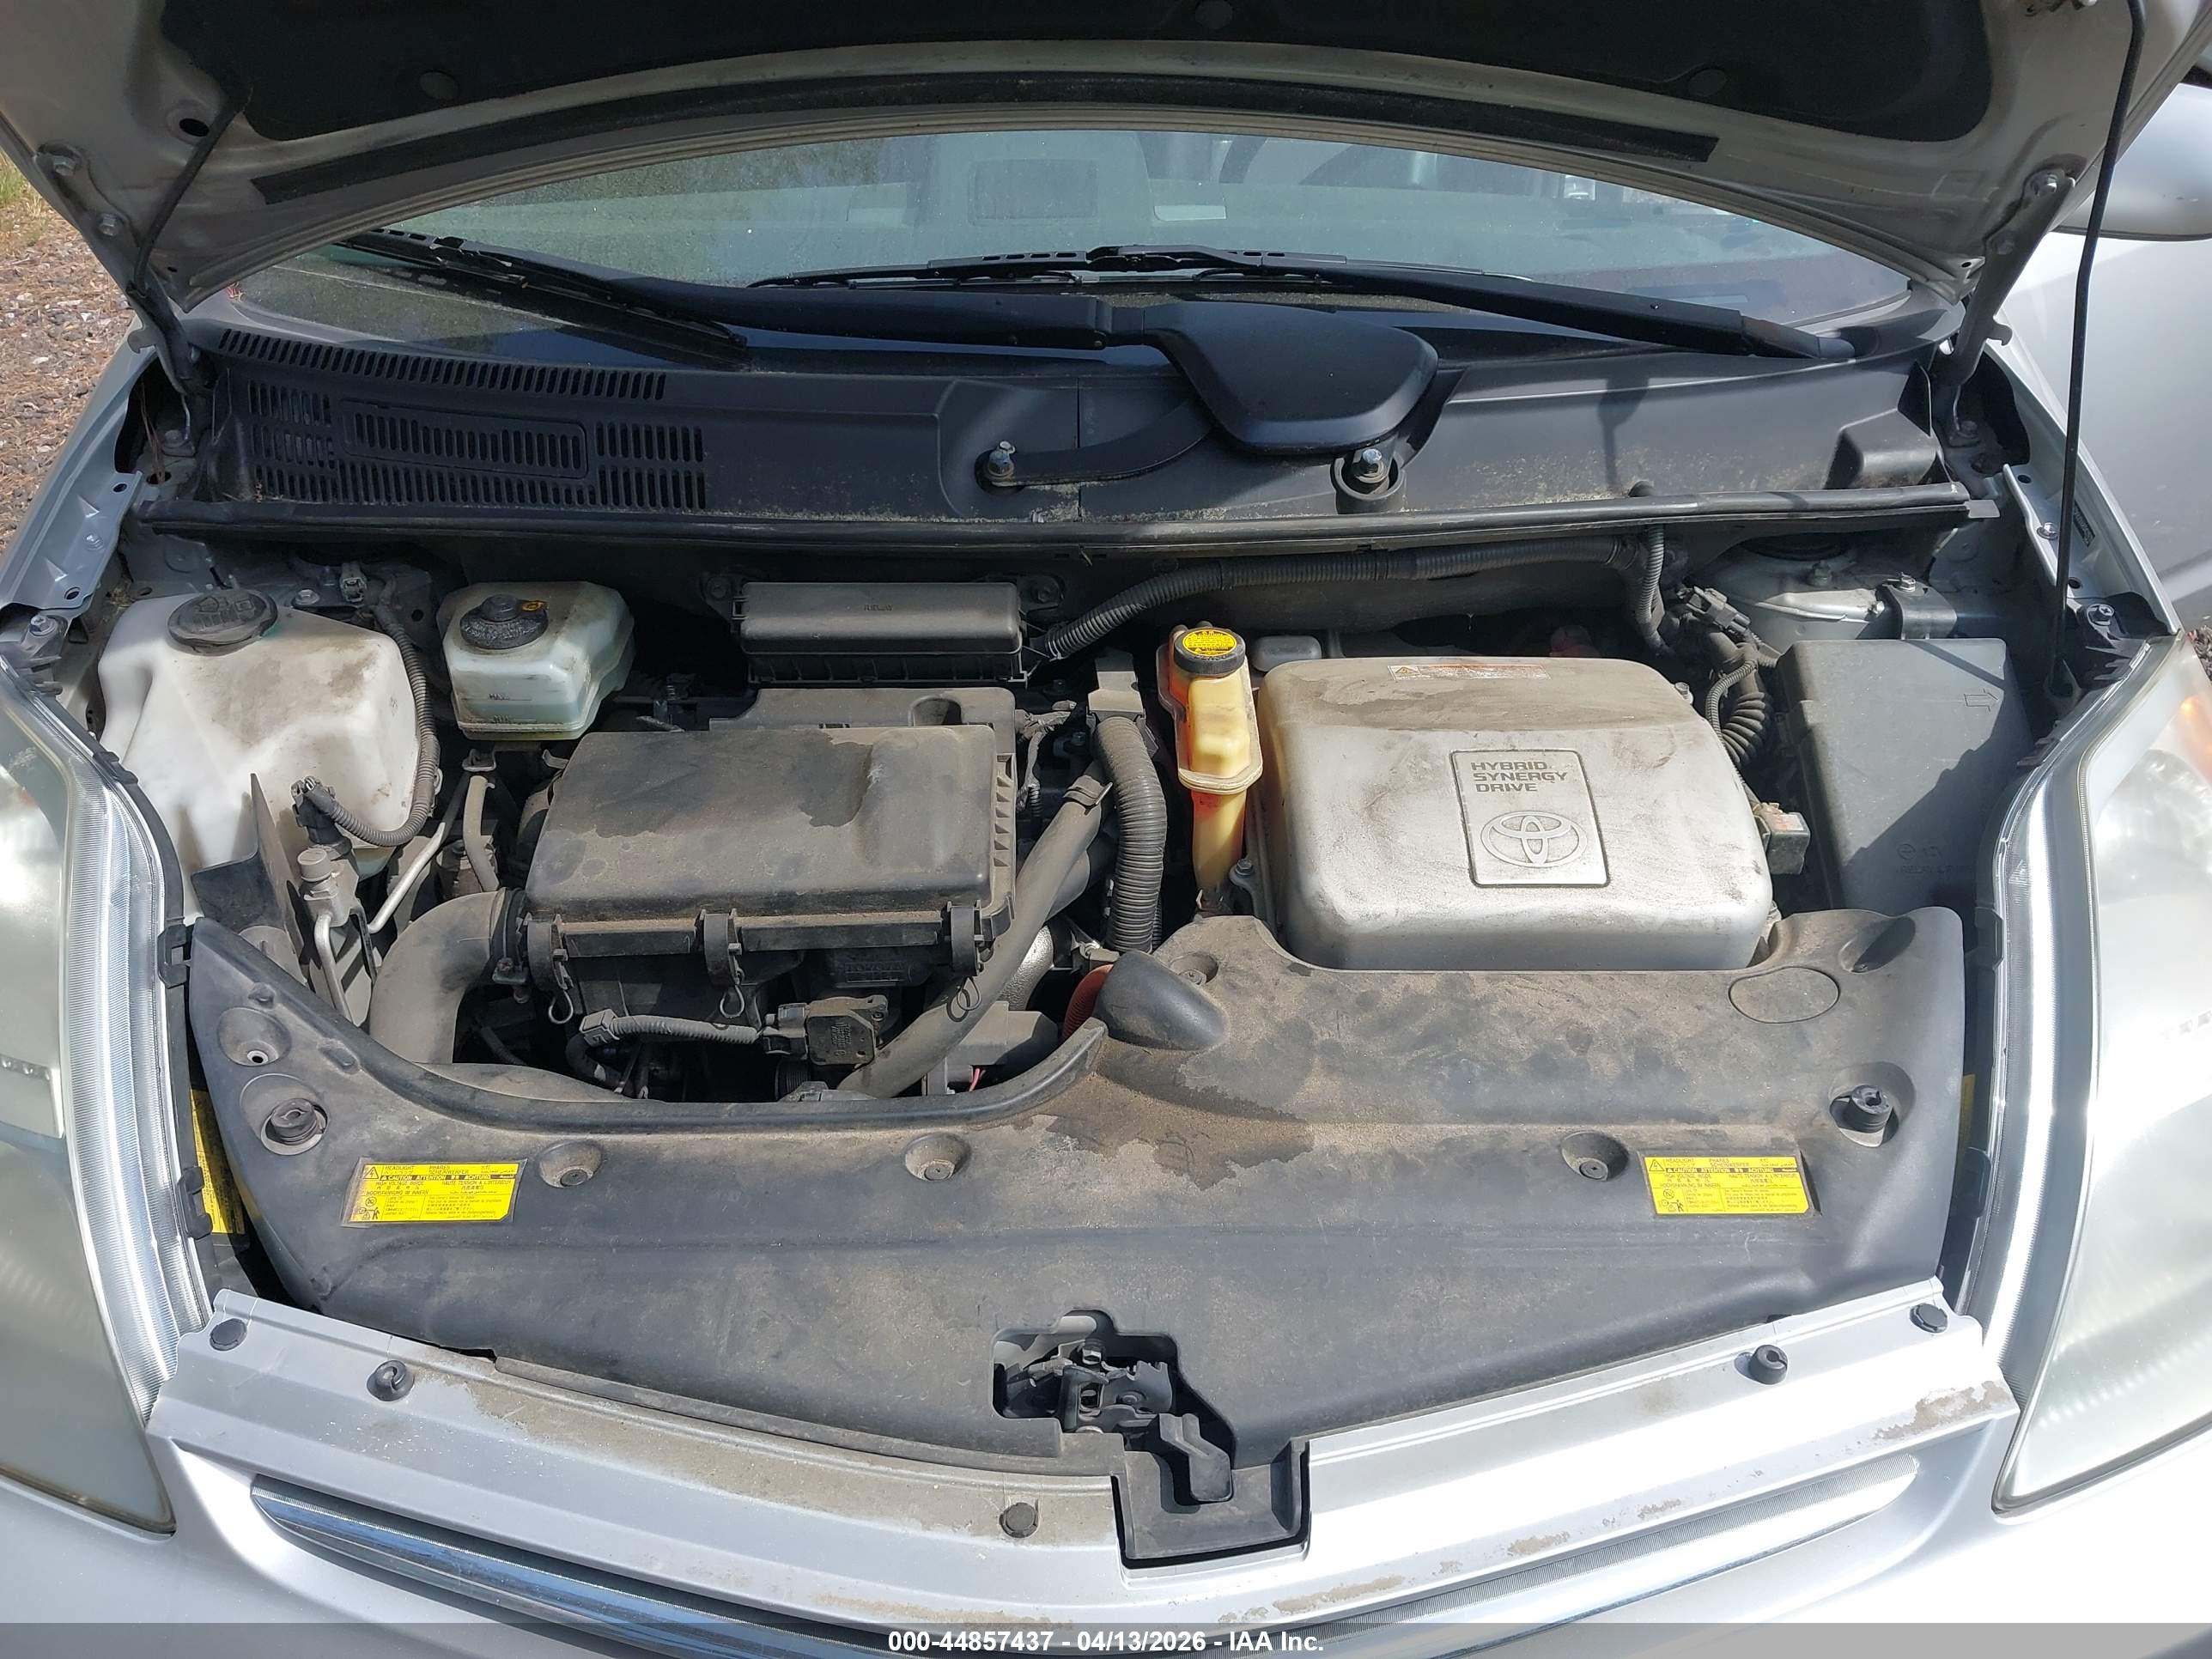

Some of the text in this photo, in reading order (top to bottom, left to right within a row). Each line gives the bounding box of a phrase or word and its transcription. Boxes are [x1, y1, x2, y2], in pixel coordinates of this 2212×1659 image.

[1470, 762, 1548, 771] HYBRID
[1473, 771, 1568, 781] SYNERGY
[1476, 782, 1538, 793] DRIVE
